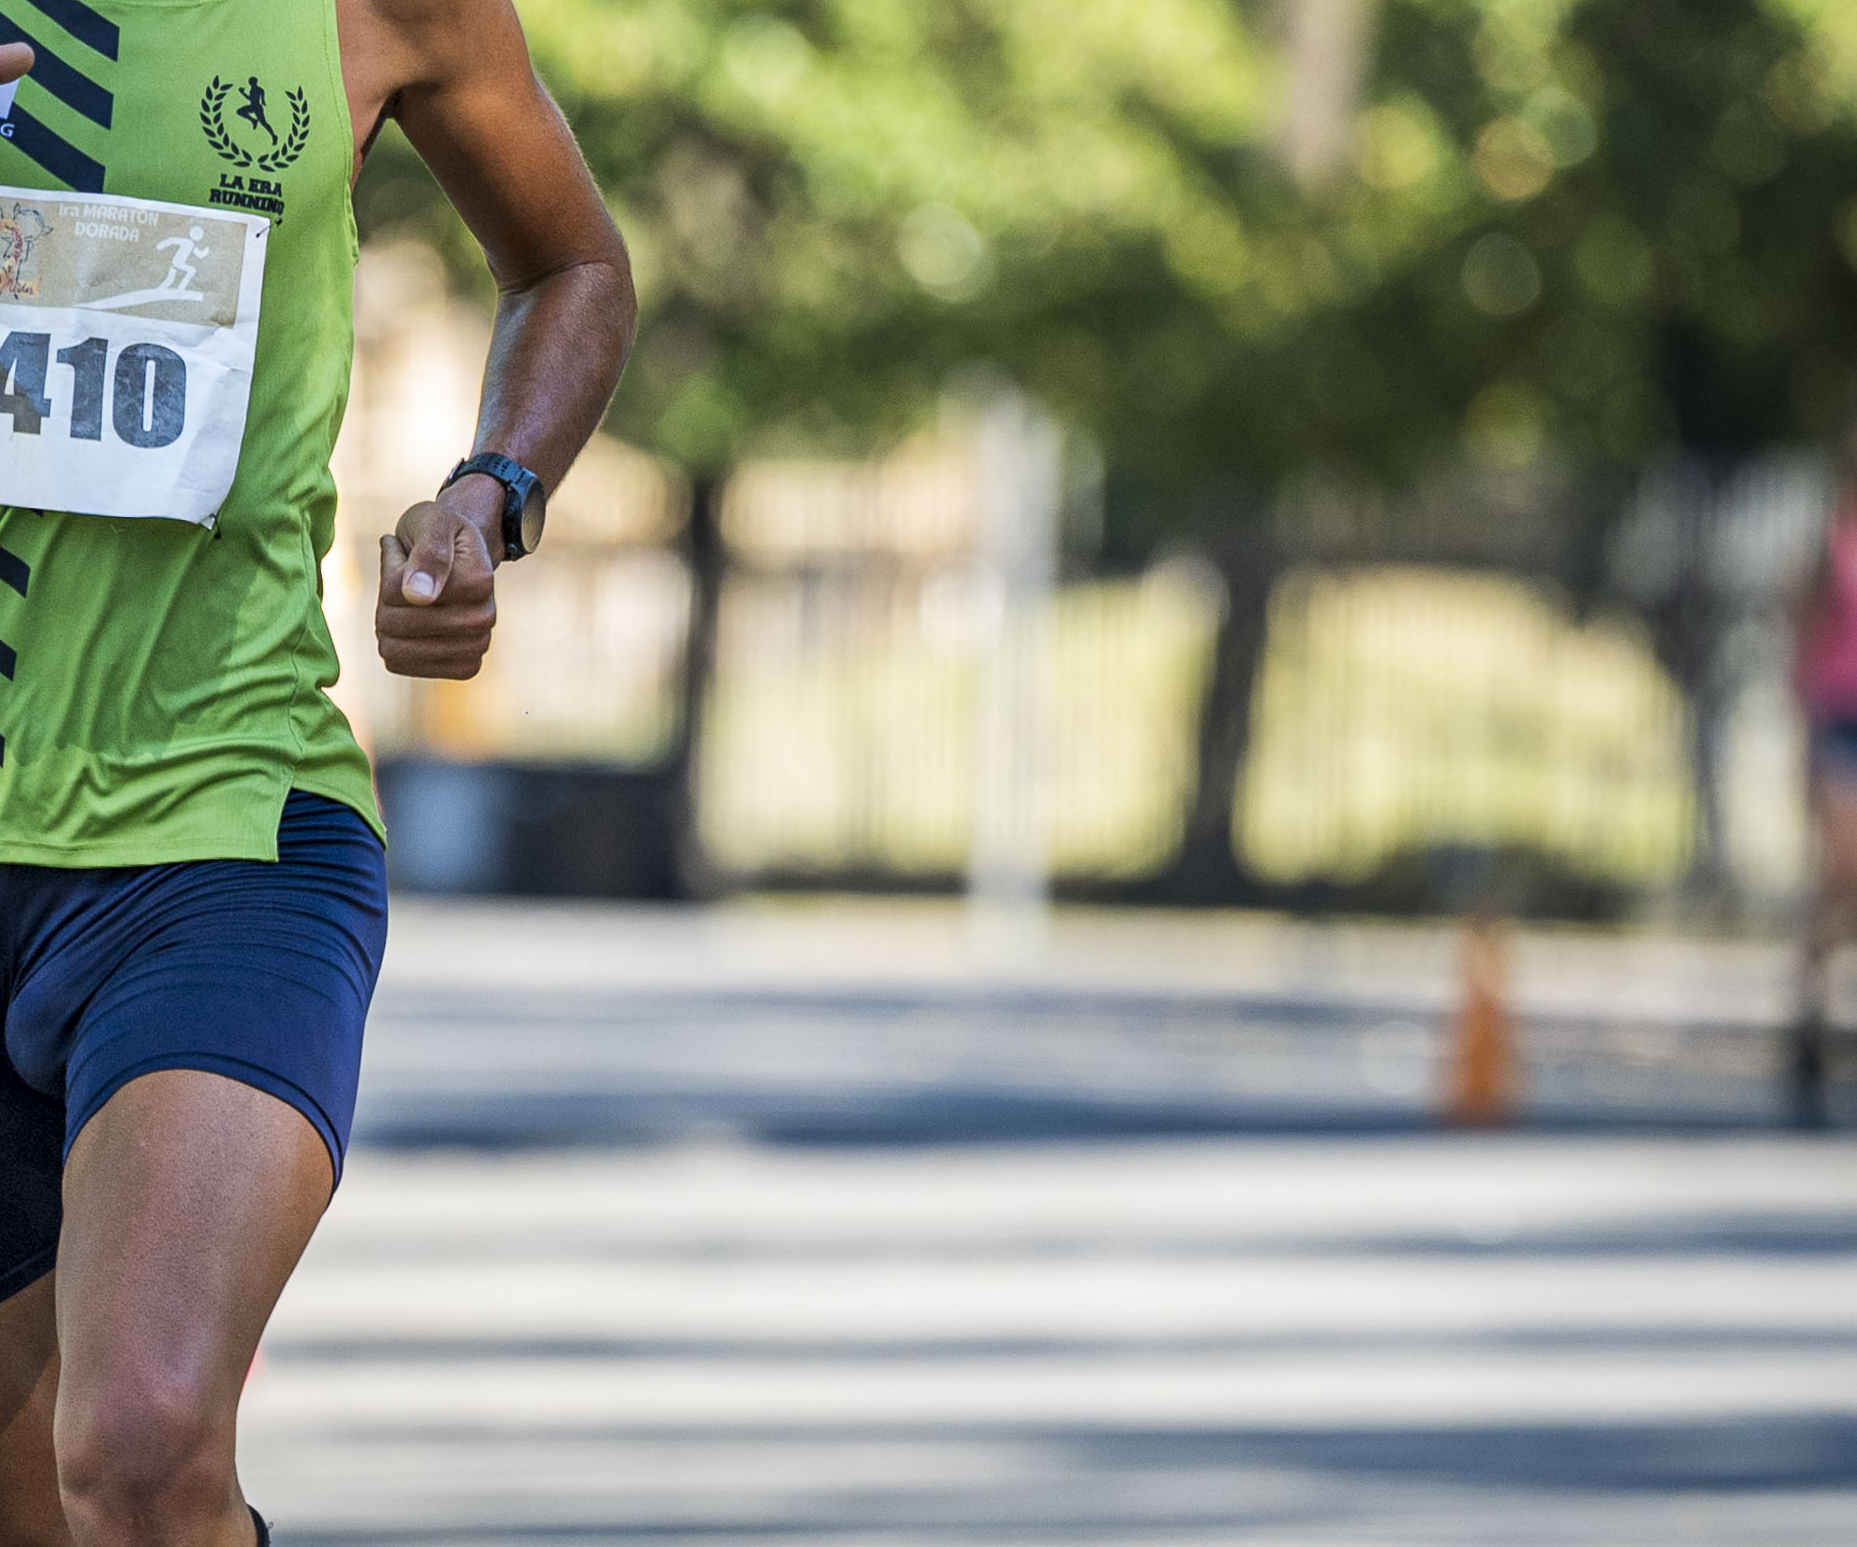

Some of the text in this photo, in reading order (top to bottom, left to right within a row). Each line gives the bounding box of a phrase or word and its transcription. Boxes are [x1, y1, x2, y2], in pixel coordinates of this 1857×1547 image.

[219, 173, 282, 197] LA ERA
[75, 221, 139, 242] DORADA
